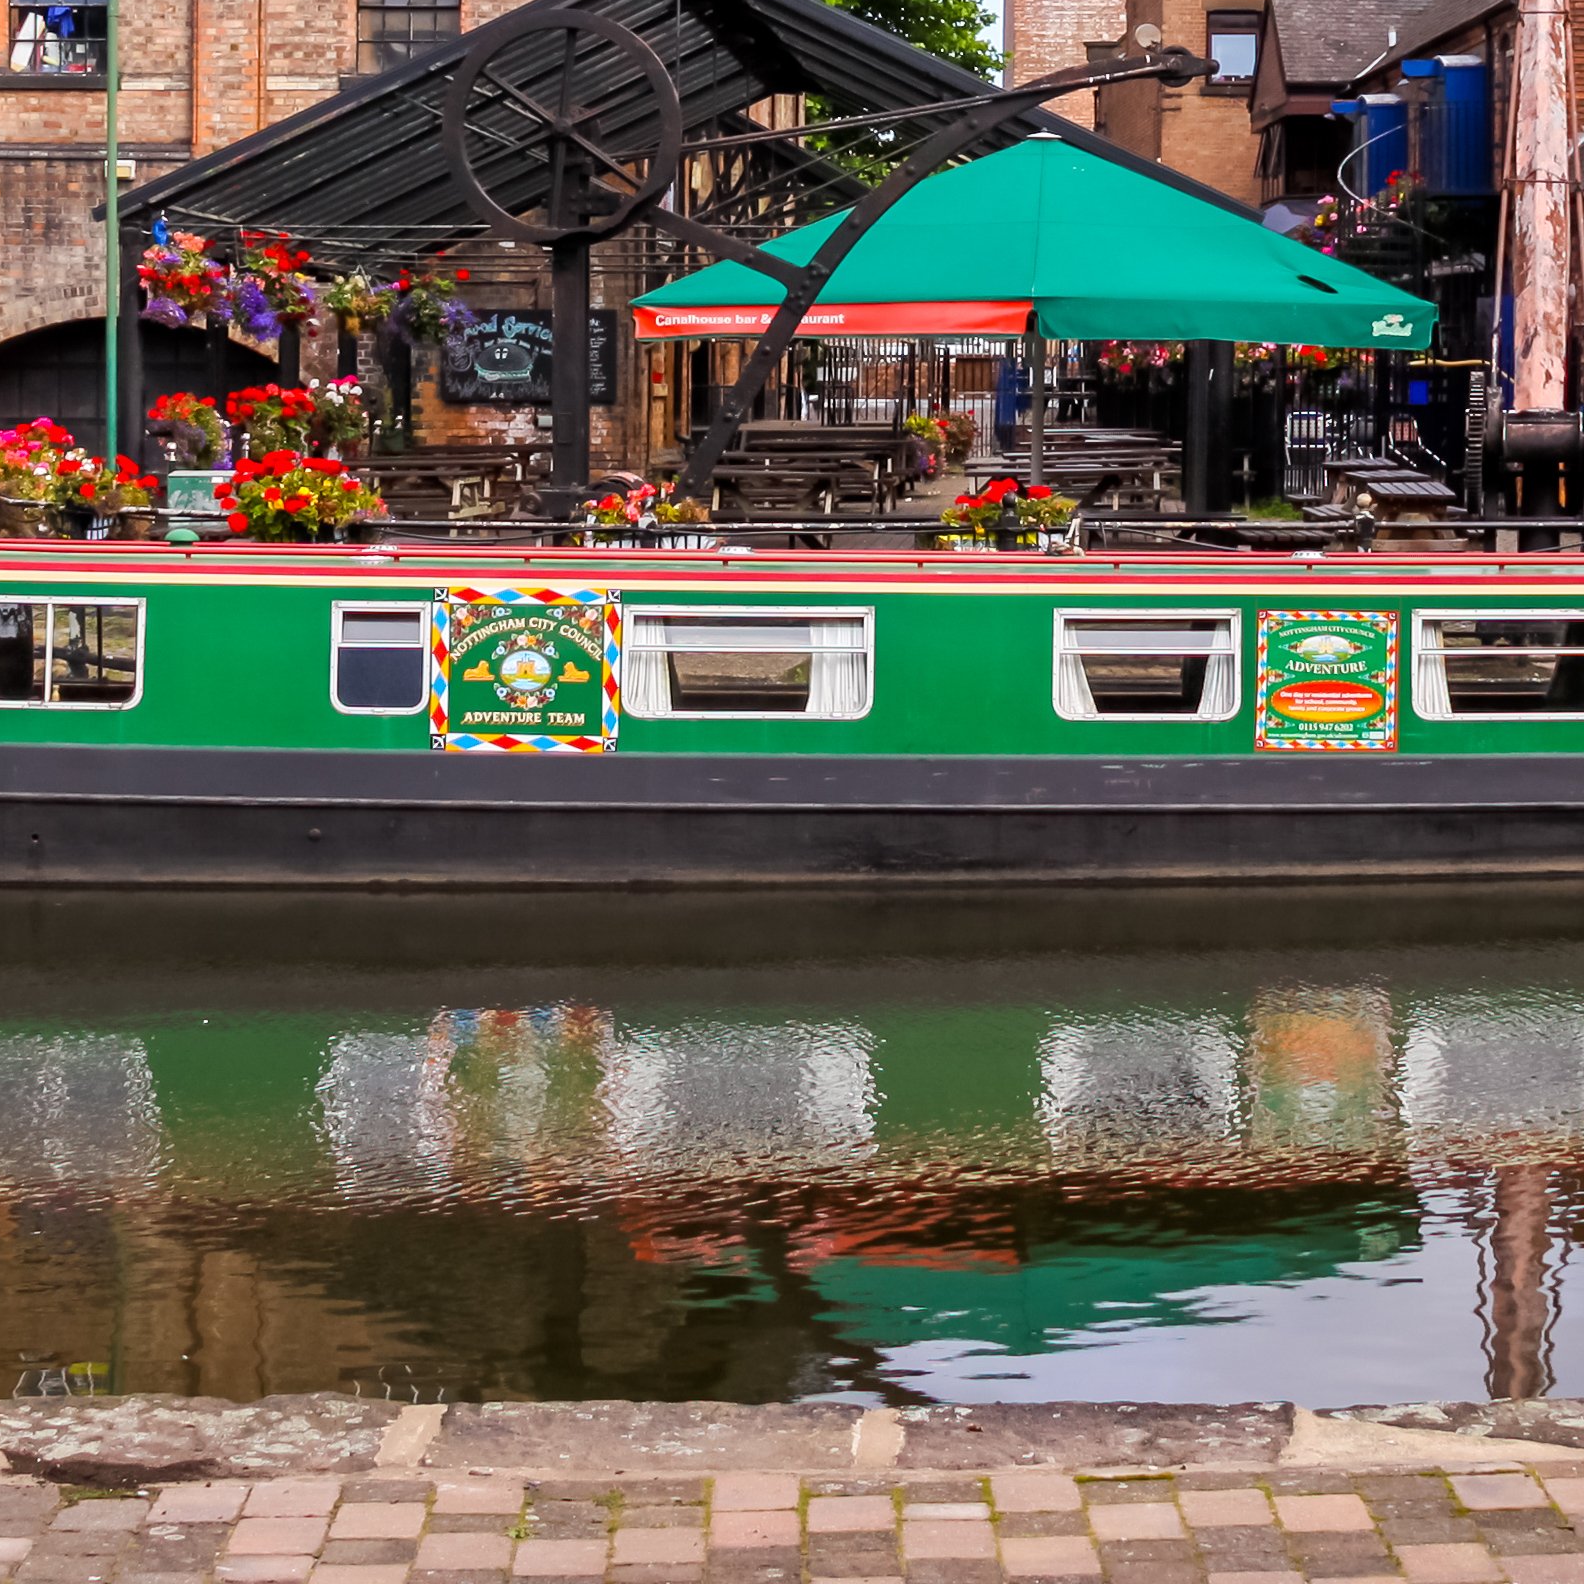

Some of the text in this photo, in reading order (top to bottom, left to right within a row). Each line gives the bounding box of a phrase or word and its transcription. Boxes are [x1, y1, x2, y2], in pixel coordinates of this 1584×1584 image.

[656, 313, 845, 326] Canalhouse bar & aurant
[1279, 626, 1327, 639] NOTTINGHAM
[449, 617, 604, 664] NOTTINGHAM CITY COUNCIL
[1285, 660, 1368, 674] ADVENTURE
[461, 711, 586, 726] ADVENTURE TEAM
[1319, 723, 1334, 731] 947
